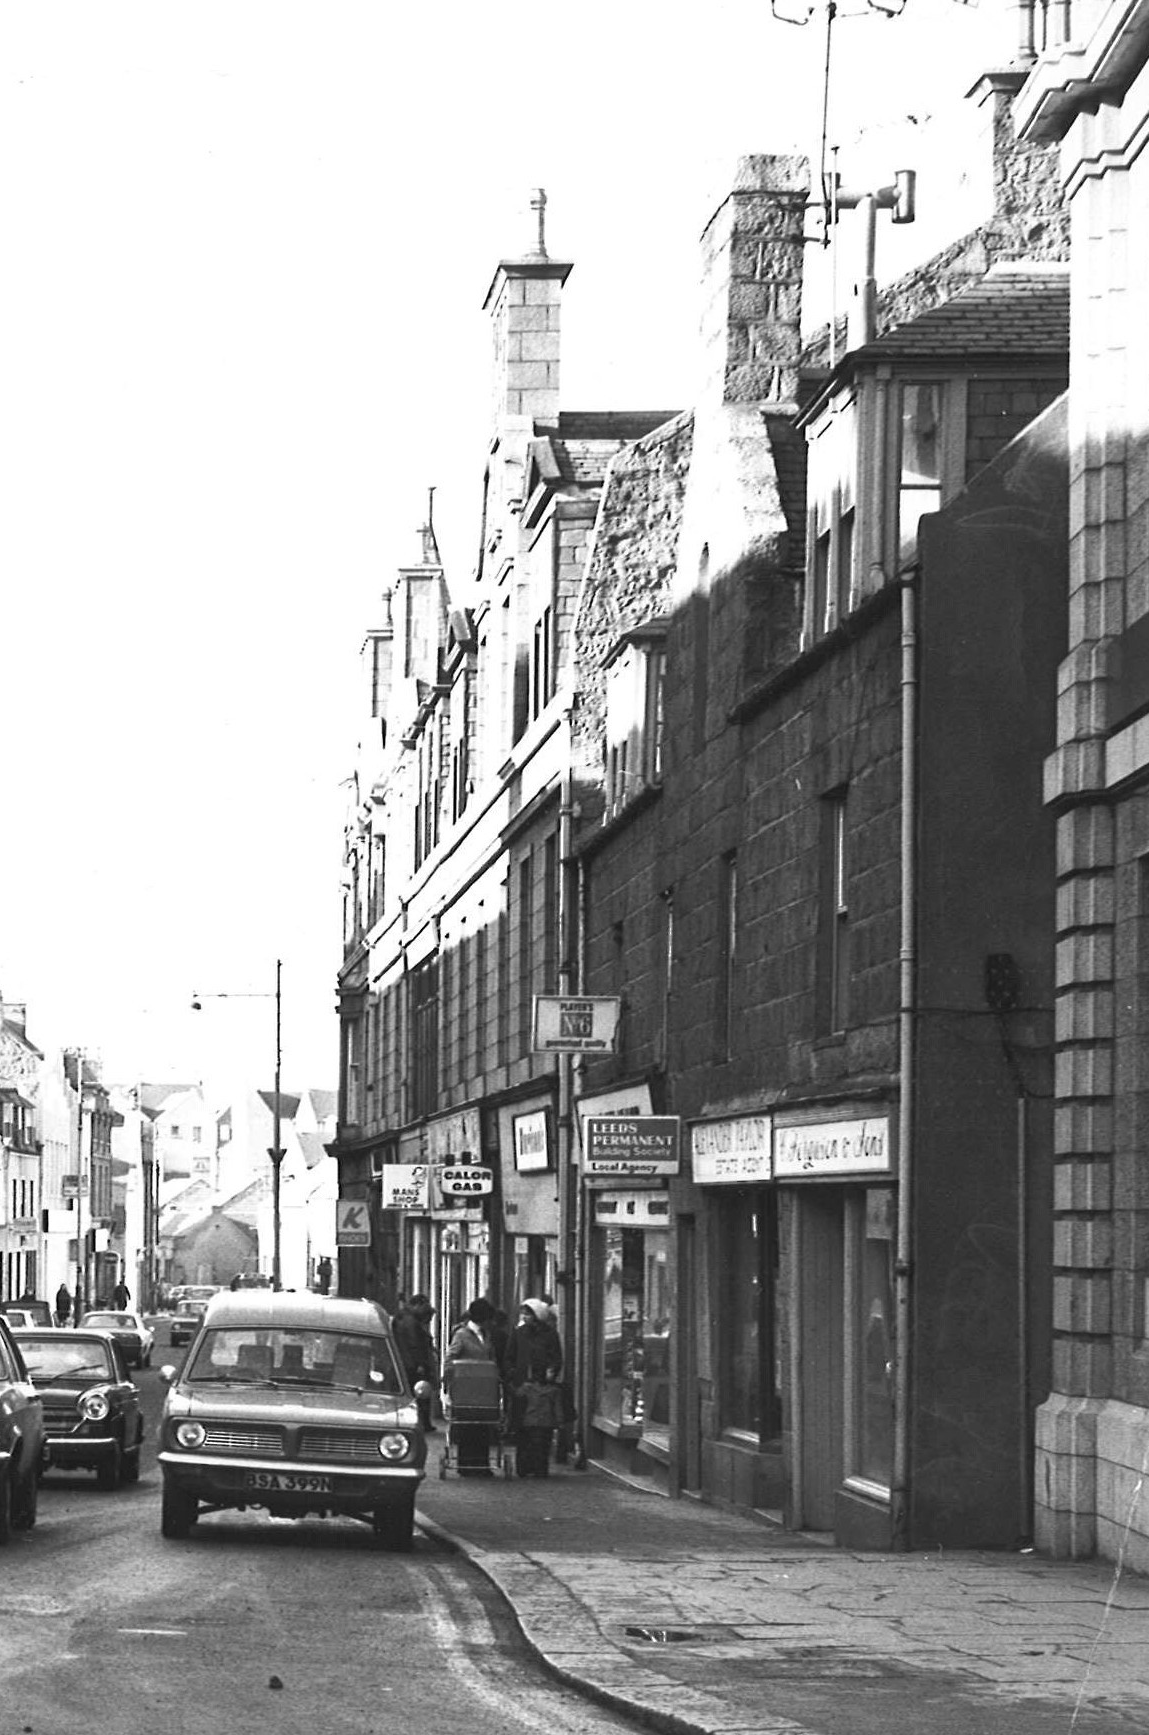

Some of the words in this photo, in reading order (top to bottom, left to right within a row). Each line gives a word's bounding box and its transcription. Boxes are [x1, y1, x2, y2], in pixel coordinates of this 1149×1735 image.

[593, 1123, 638, 1133] LEEDS
[593, 1135, 674, 1146] PERMANENT
[592, 1147, 631, 1157] Building
[633, 1146, 672, 1157] Society
[592, 1162, 619, 1171] Local
[621, 1162, 659, 1174] Agency
[444, 1171, 492, 1180] CALOR
[452, 1182, 483, 1191] GAS
[393, 1196, 419, 1204] SHOP
[284, 1475, 332, 1492] 399N
